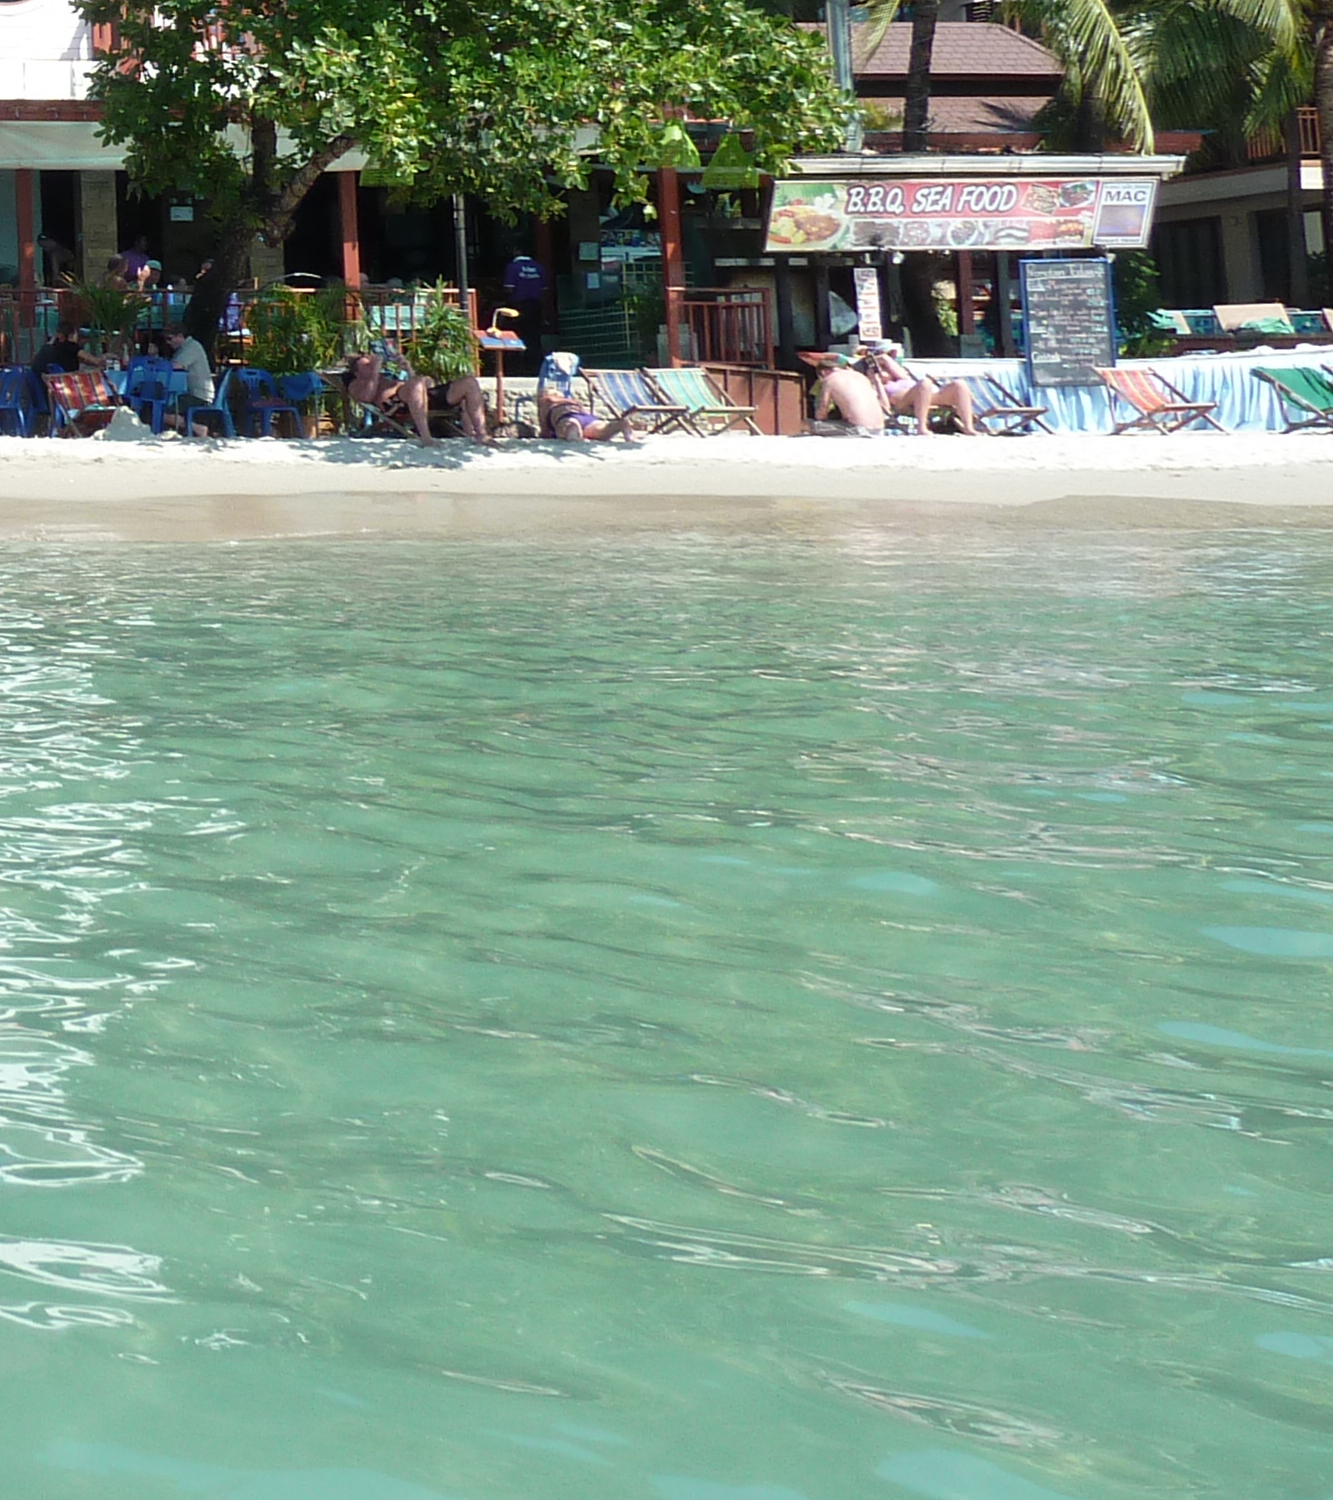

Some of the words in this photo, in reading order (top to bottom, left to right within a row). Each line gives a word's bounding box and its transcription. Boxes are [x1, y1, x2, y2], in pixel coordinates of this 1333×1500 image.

[912, 186, 953, 212] SEA
[957, 185, 1017, 212] FOOD
[1104, 190, 1147, 203] MAC
